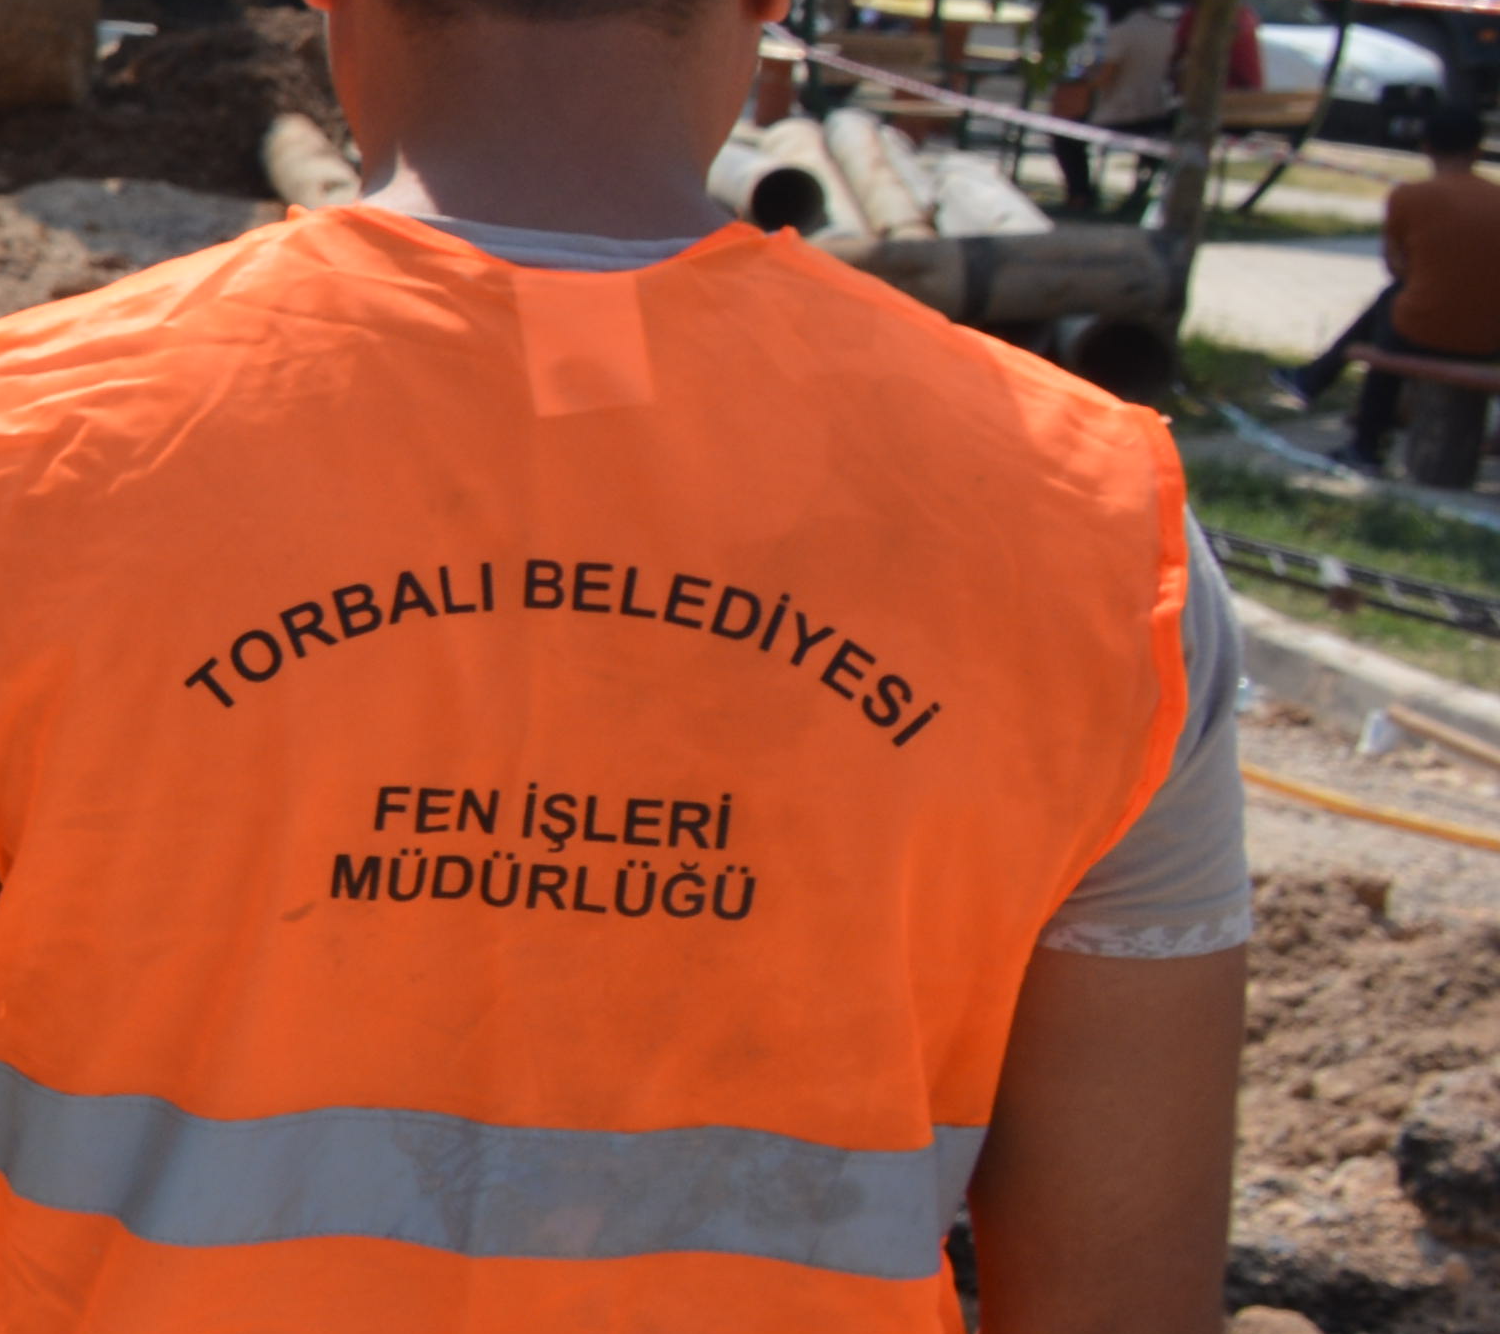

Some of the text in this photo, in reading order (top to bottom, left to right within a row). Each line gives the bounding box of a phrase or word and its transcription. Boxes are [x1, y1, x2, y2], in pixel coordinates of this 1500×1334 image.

[184, 558, 942, 748] TORBALI BELEDİYESİ
[373, 782, 733, 852] FEN İŞLERİ
[330, 848, 757, 922] MÜDÜRLÜĞÜ
